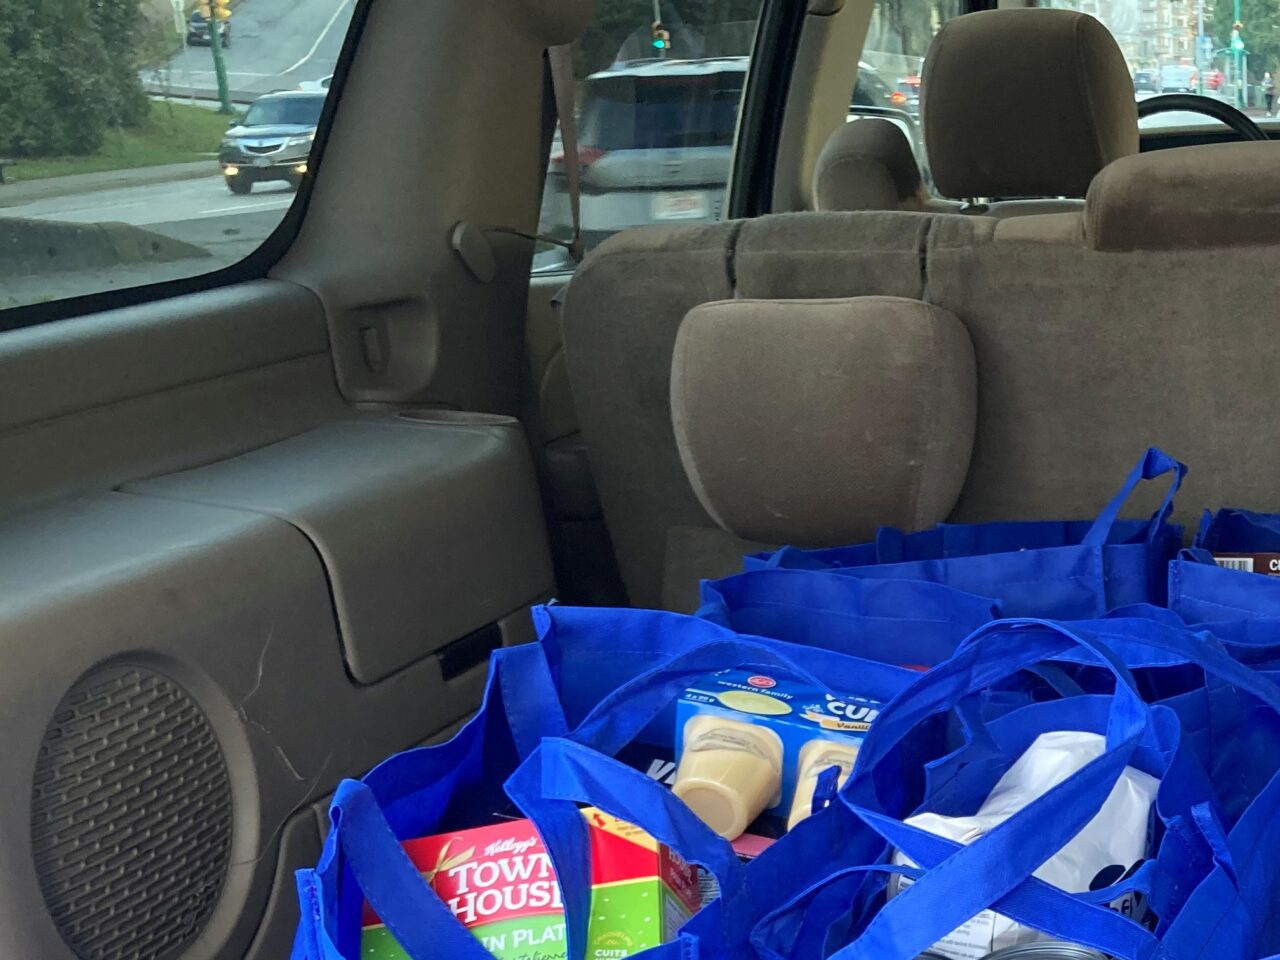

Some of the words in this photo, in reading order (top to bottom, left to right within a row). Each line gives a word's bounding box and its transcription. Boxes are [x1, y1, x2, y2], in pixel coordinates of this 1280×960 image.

[718, 680, 759, 693] western
[760, 688, 794, 700] family
[484, 836, 538, 856] Kellogg's
[595, 949, 628, 957] CUITS
